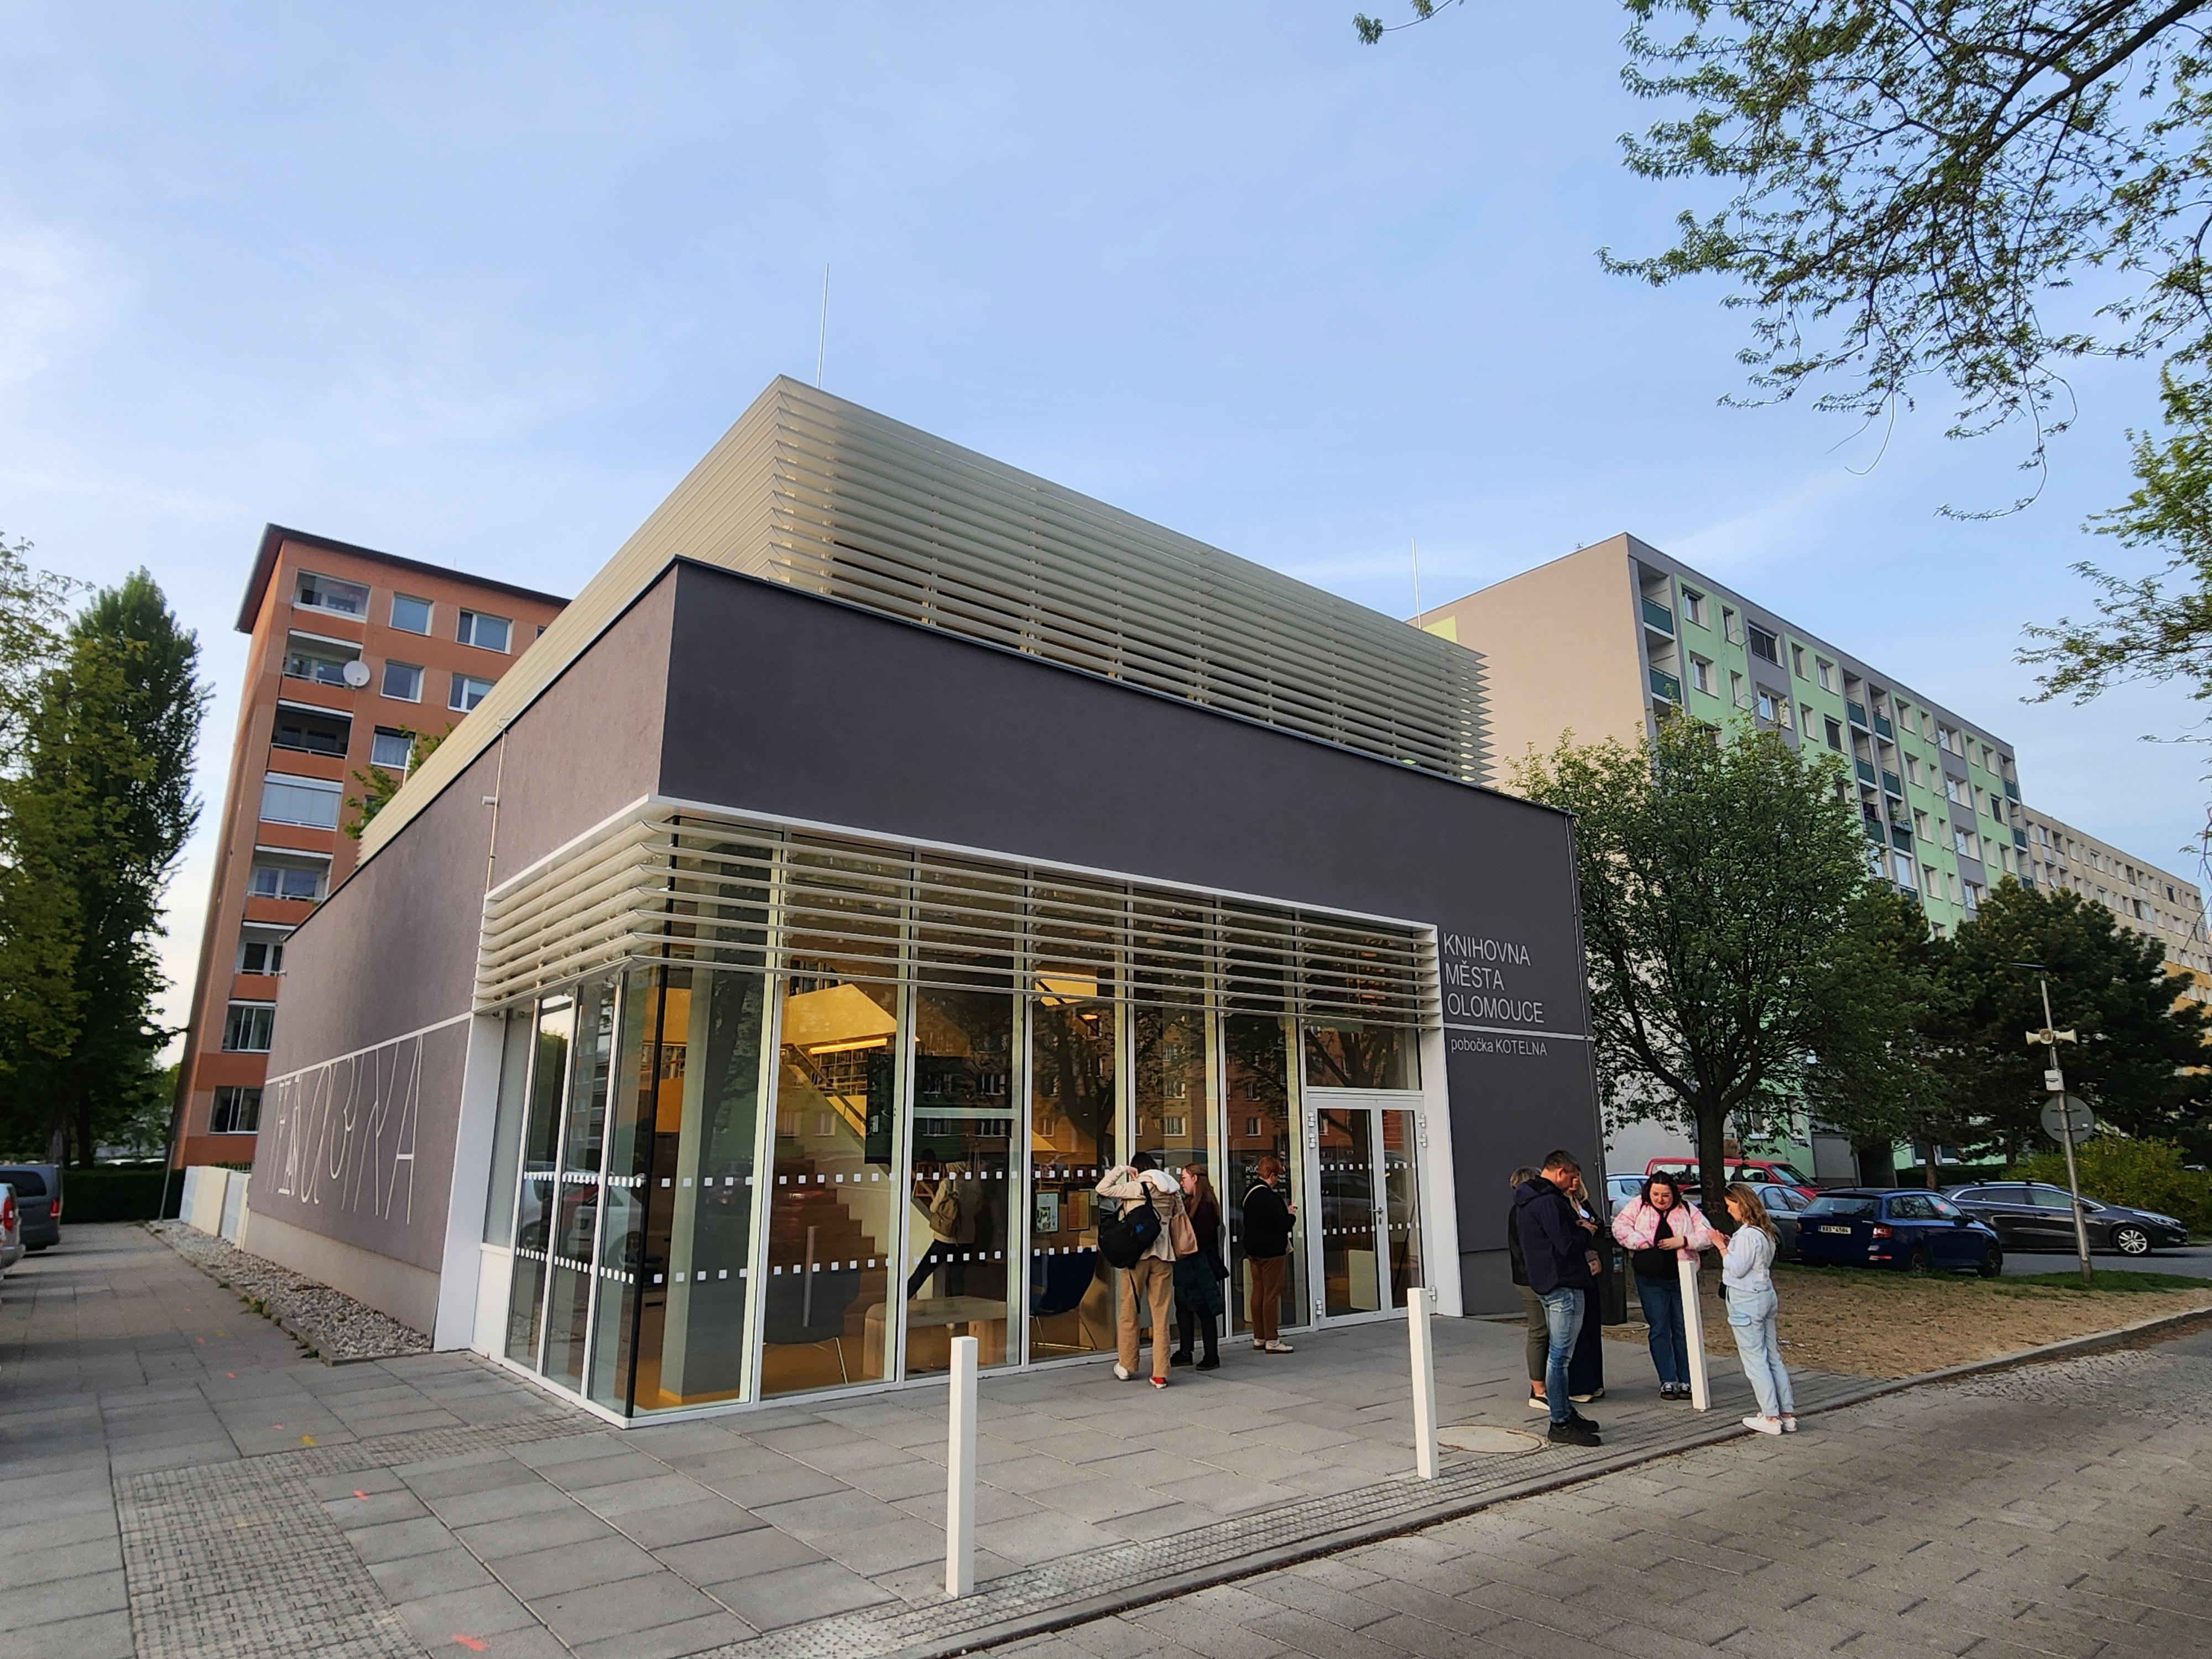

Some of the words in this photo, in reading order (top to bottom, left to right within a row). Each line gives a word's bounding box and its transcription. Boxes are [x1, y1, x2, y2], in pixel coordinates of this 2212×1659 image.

[1443, 932, 1531, 966] KNIHOVNA
[1445, 959, 1505, 990] MĚSTA
[1447, 993, 1545, 1023] OLOMOUCE
[1451, 1037, 1493, 1053] pobočka
[1495, 1039, 1547, 1056] KOTELNA
